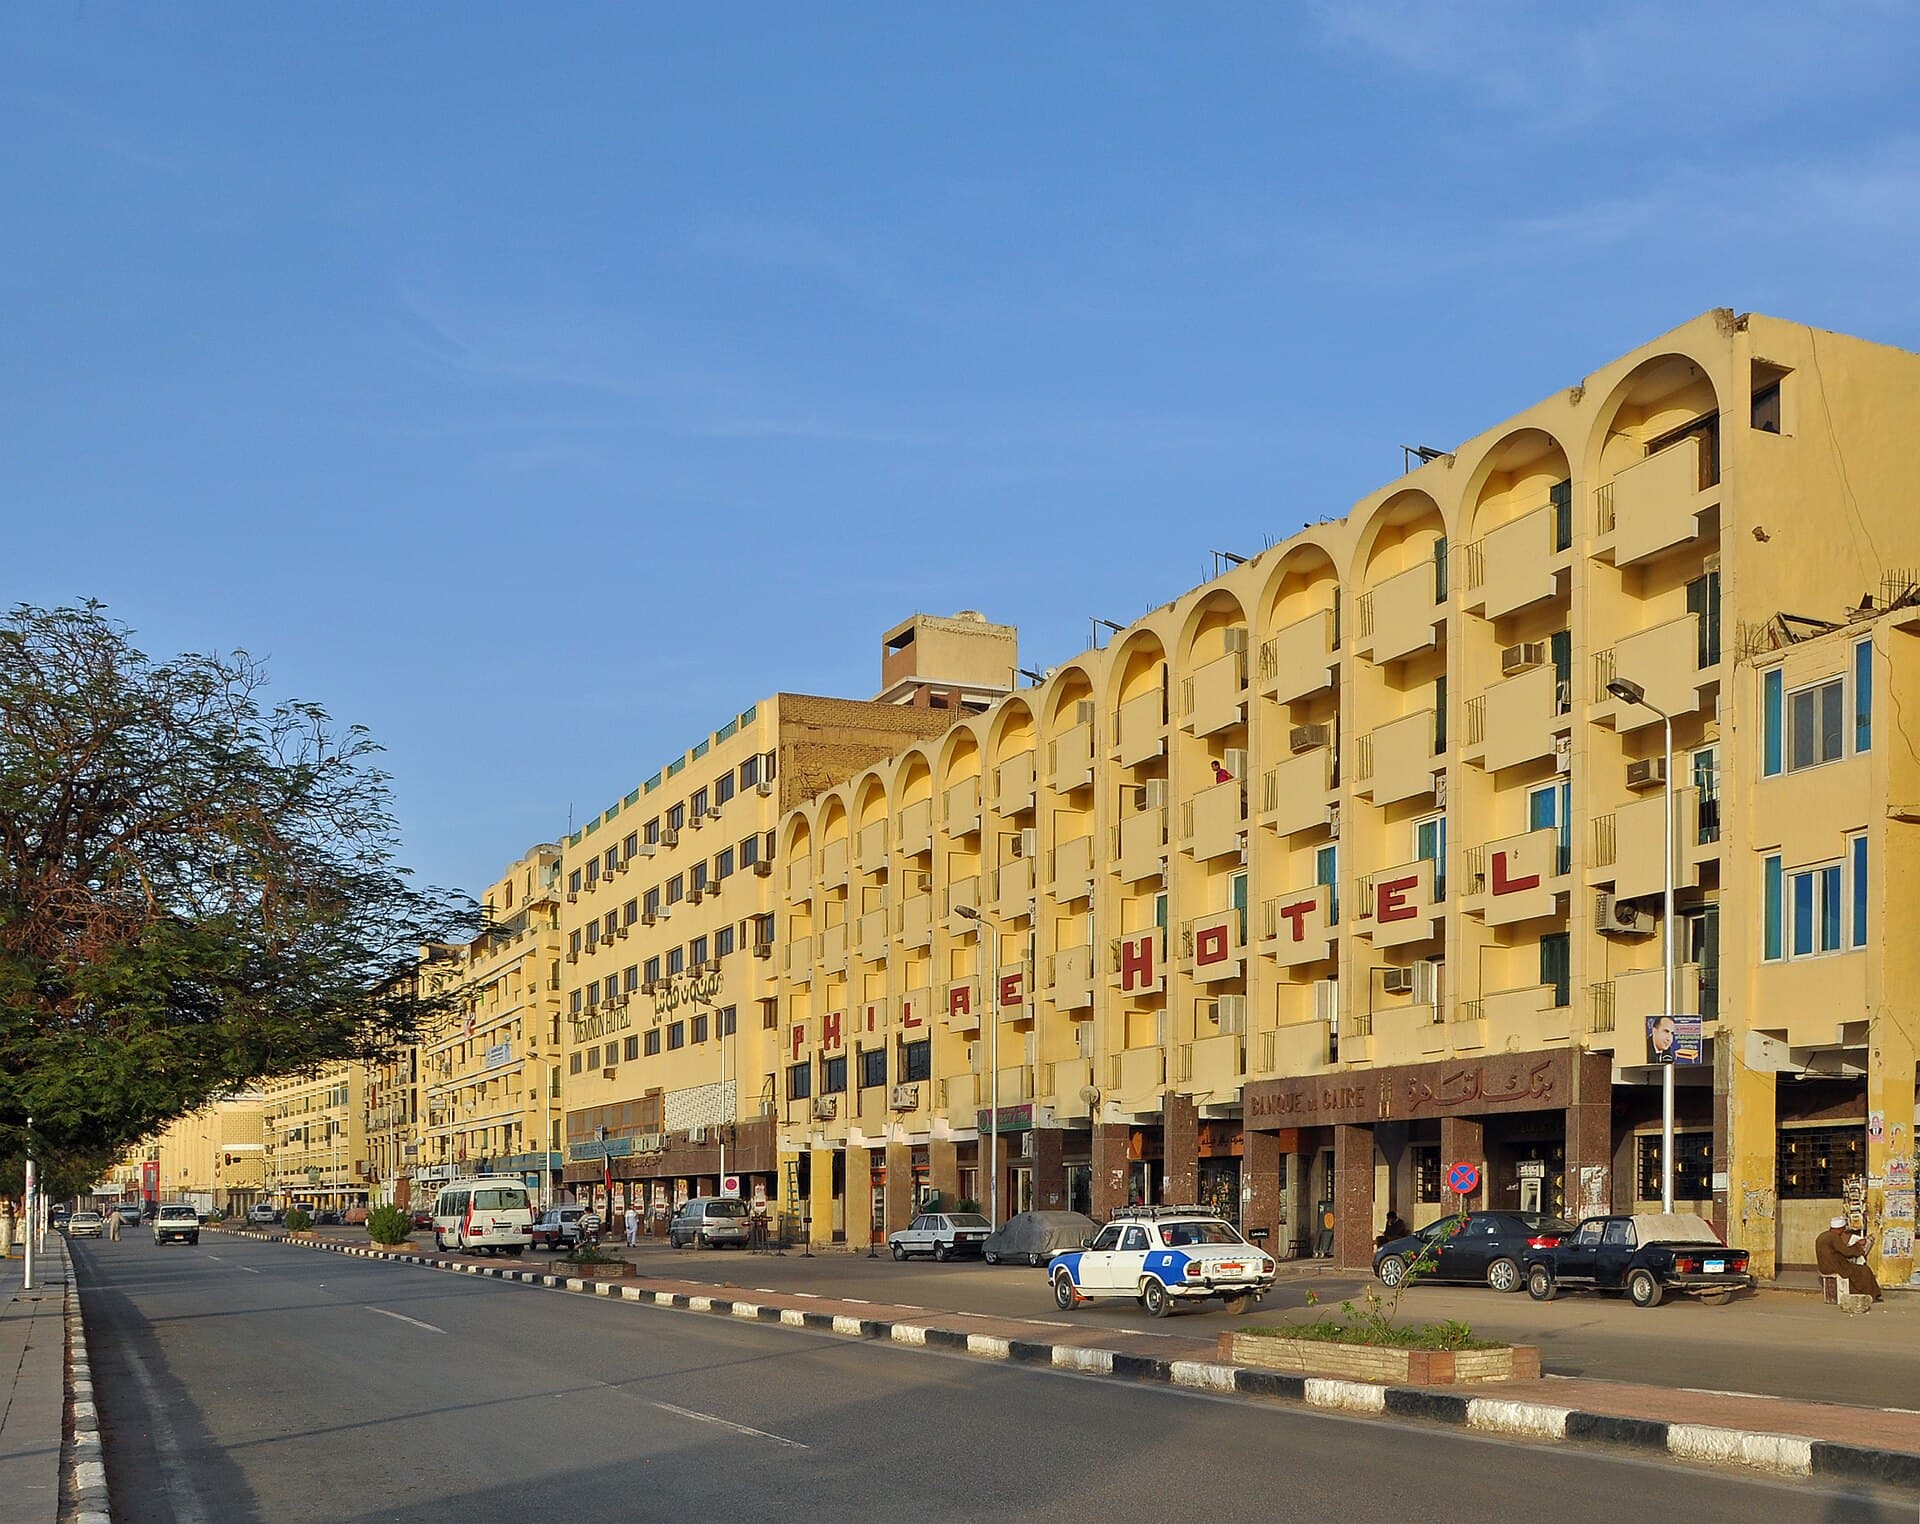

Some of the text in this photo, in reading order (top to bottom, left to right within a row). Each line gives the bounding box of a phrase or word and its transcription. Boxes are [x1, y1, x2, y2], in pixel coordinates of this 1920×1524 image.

[793, 851, 1541, 1059] PHILAE HOTEL
[605, 1003, 631, 1035] HOTEL
[1251, 1092, 1305, 1117] BANQUE
[1321, 1085, 1367, 1110] CAIRE
[1408, 1059, 1554, 1113] بنك القاهرة
